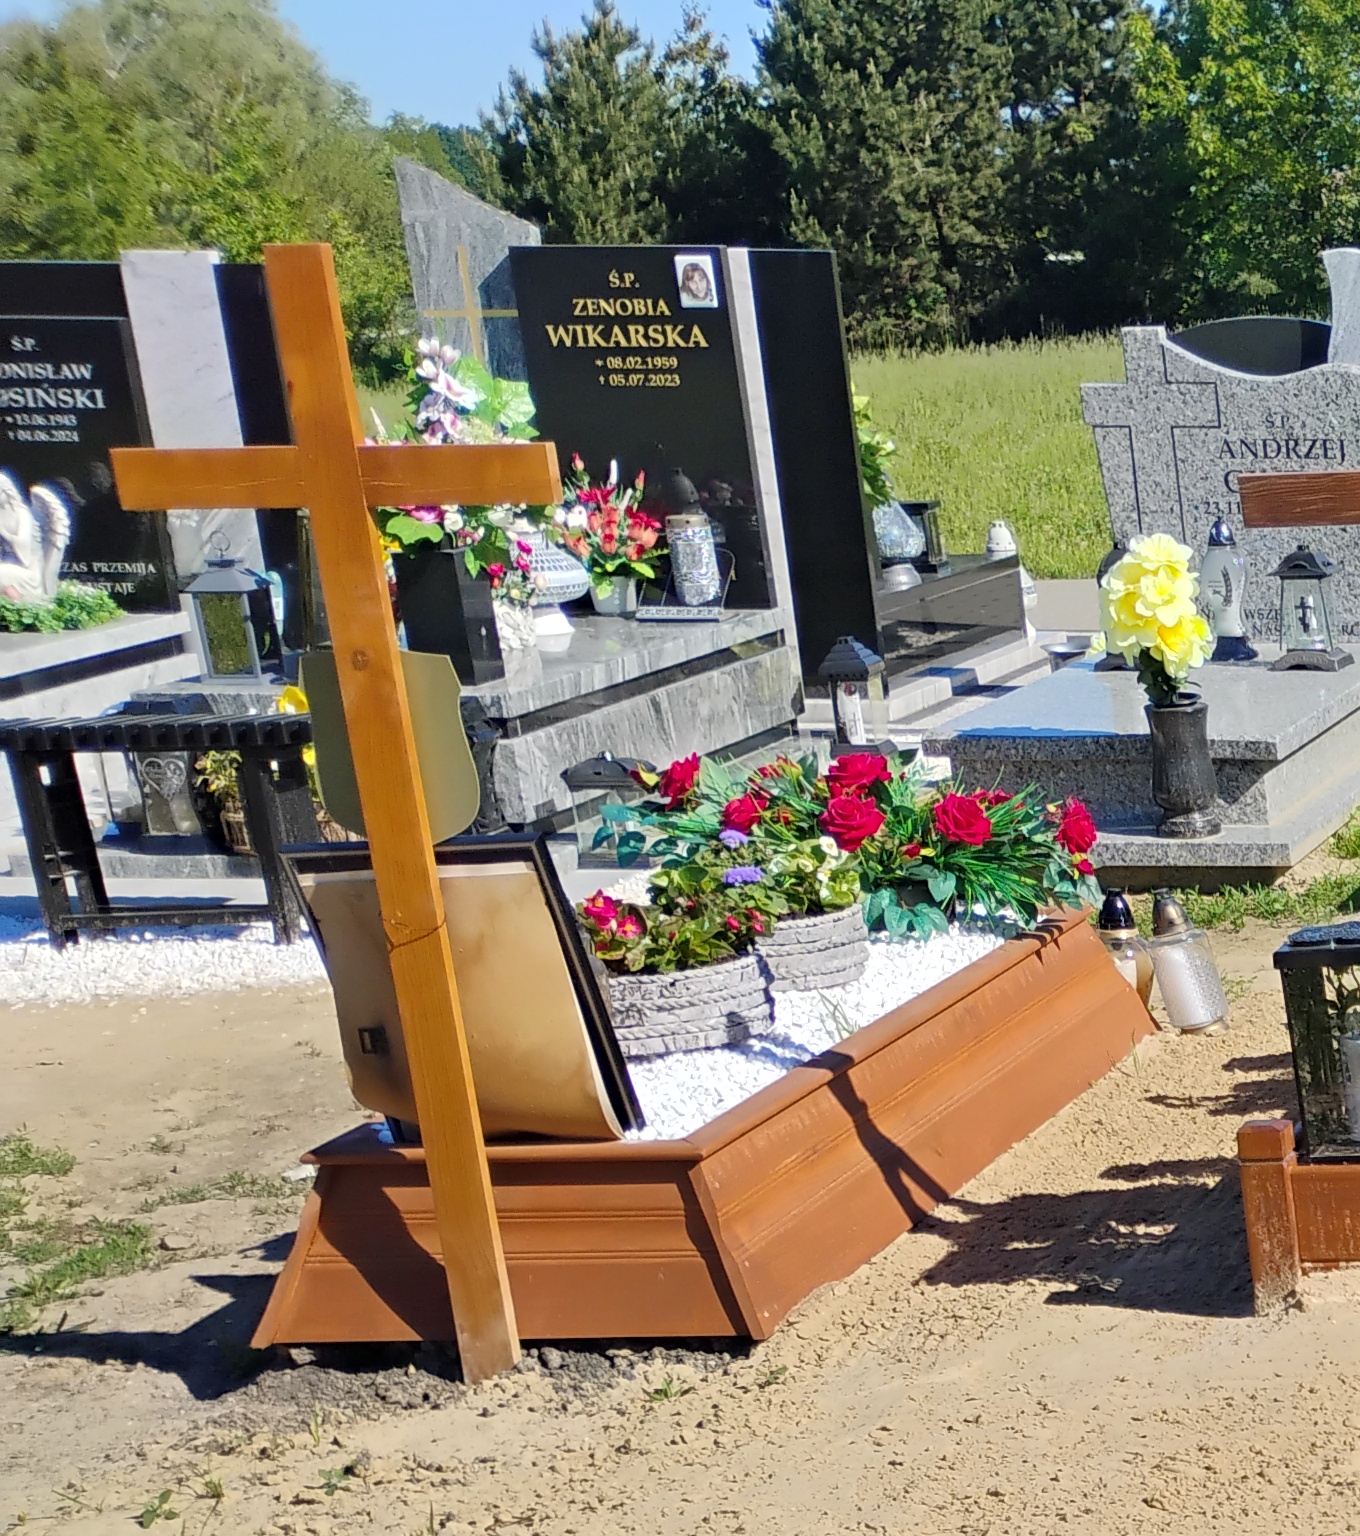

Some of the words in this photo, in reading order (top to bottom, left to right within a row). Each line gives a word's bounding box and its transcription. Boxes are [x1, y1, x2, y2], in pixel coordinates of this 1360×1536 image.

[608, 269, 640, 288] Ś.P.
[572, 298, 672, 316] ZENOBIA
[545, 324, 709, 348] WIKARSKA
[606, 356, 678, 369] 08.02.1959
[609, 374, 680, 387] 05.07.2023
[1219, 438, 1346, 465] ANDRZEJ
